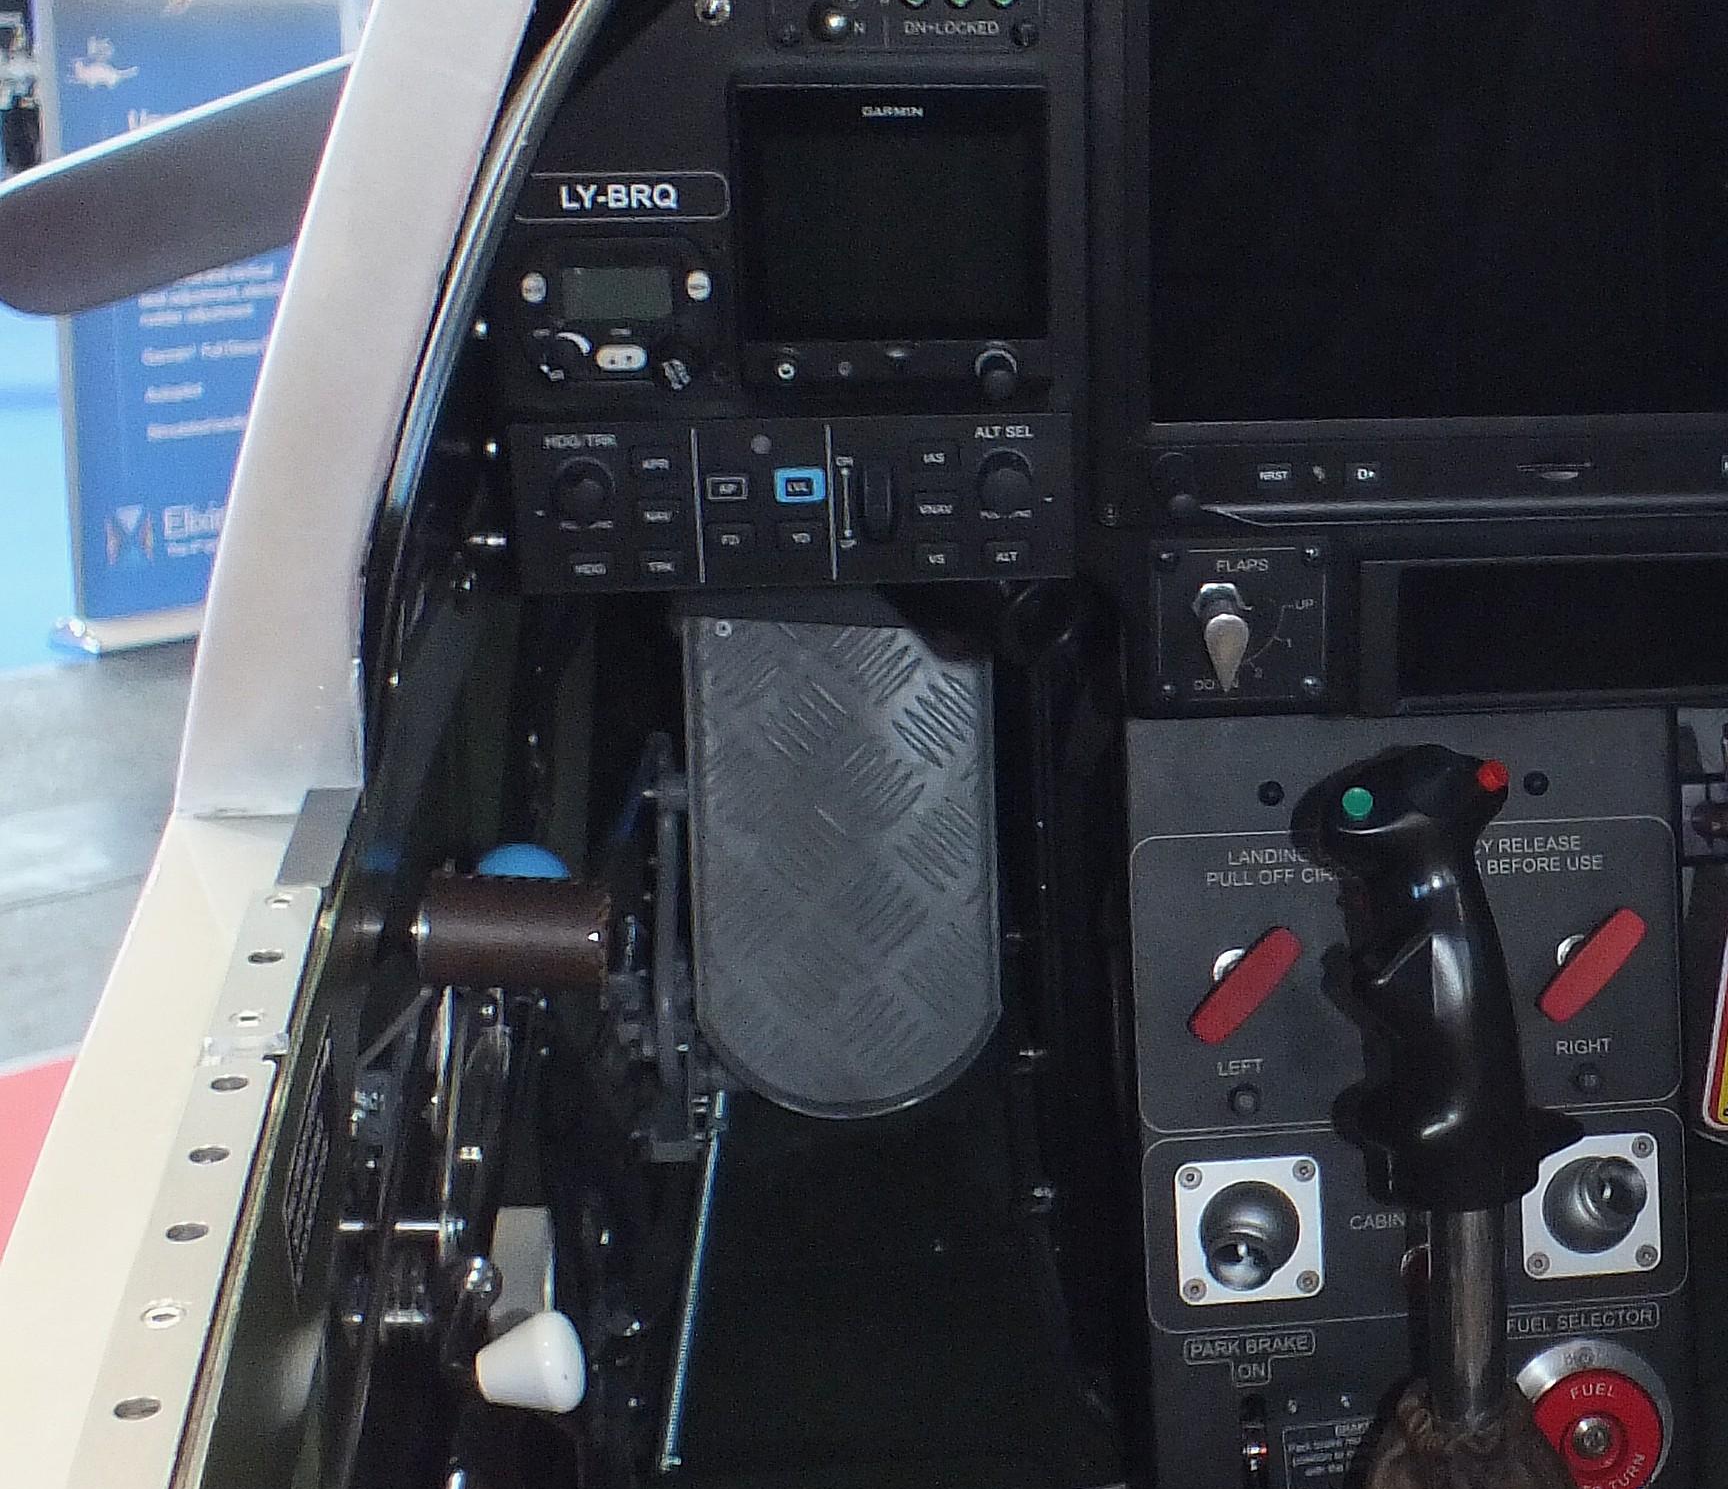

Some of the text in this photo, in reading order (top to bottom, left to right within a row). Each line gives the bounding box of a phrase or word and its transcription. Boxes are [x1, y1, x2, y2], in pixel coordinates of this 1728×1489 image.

[904, 21, 1000, 36] DN-LOCKED
[861, 106, 924, 118] GARMIN
[560, 183, 678, 211] LY-BRQ
[974, 425, 1034, 439] ALT SEL
[928, 554, 945, 565] VS
[995, 551, 1018, 562] ALT
[1216, 559, 1269, 573] FLAPS
[1295, 598, 1314, 610] UP
[1498, 835, 1581, 854] RELEASE
[1487, 855, 1561, 875] BEFORE
[1567, 853, 1603, 872] USE
[1206, 868, 1296, 888] PULL OFF
[1556, 1036, 1612, 1056] RIGHT
[1216, 1057, 1265, 1077] LEFT
[1350, 1212, 1405, 1231] CABIN
[1506, 1308, 1653, 1335] FUEL SELECTOR
[1188, 1335, 1310, 1359] PARK BRAKE
[1236, 1361, 1267, 1380] ON
[1568, 1382, 1616, 1400] FUEL
